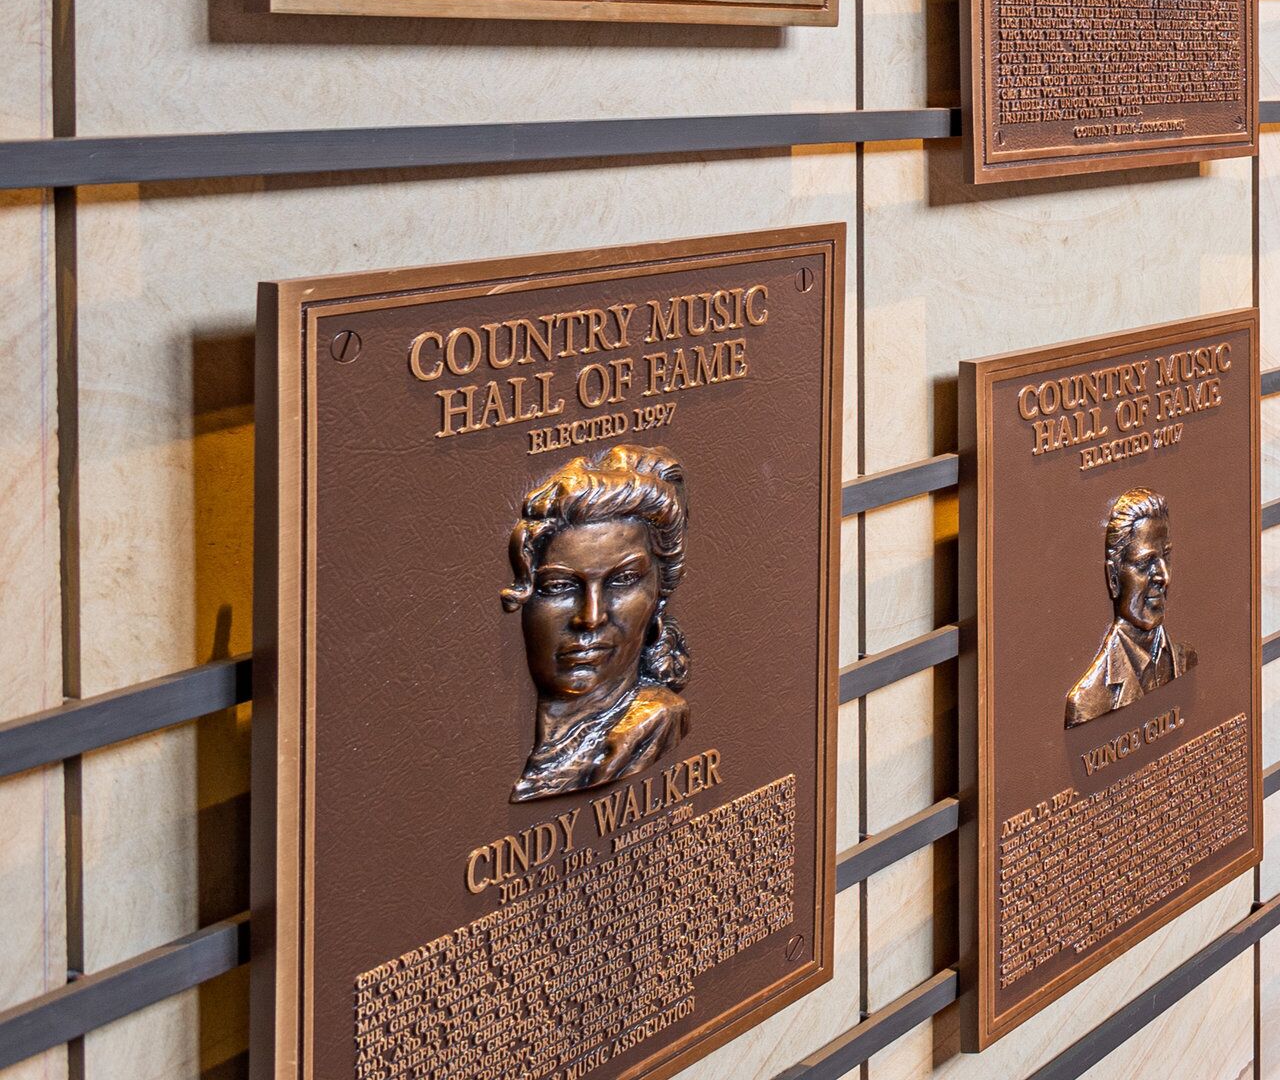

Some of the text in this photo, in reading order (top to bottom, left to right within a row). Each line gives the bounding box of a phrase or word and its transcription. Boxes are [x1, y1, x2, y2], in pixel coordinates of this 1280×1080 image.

[409, 284, 769, 382] COUNTRY MUSIC
[434, 338, 749, 439] HALL OF FAME
[1017, 342, 1232, 420] COUNTRY MUSIC
[1032, 378, 1223, 456] HALL OF FAME
[527, 402, 678, 456] ELECTED 1997
[1080, 431, 1151, 471] ELECTED
[1080, 706, 1186, 777] VINCE GILL
[465, 748, 723, 896] CINDY WALKER
[613, 821, 654, 853] MARCH
[356, 958, 401, 990] CINDY
[401, 934, 453, 968] WALKER
[455, 927, 469, 942] IS
[471, 893, 545, 934] CONSIDERED
[549, 882, 563, 901] BY
[566, 867, 600, 891] MANY
[601, 860, 615, 874] TO
[617, 853, 631, 867] BE
[633, 844, 654, 861] ONE
[671, 826, 690, 842] THE
[499, 877, 536, 905] JULY
[564, 847, 594, 876] 1918
[566, 995, 696, 1080] MUSIC ASSOCIATION
